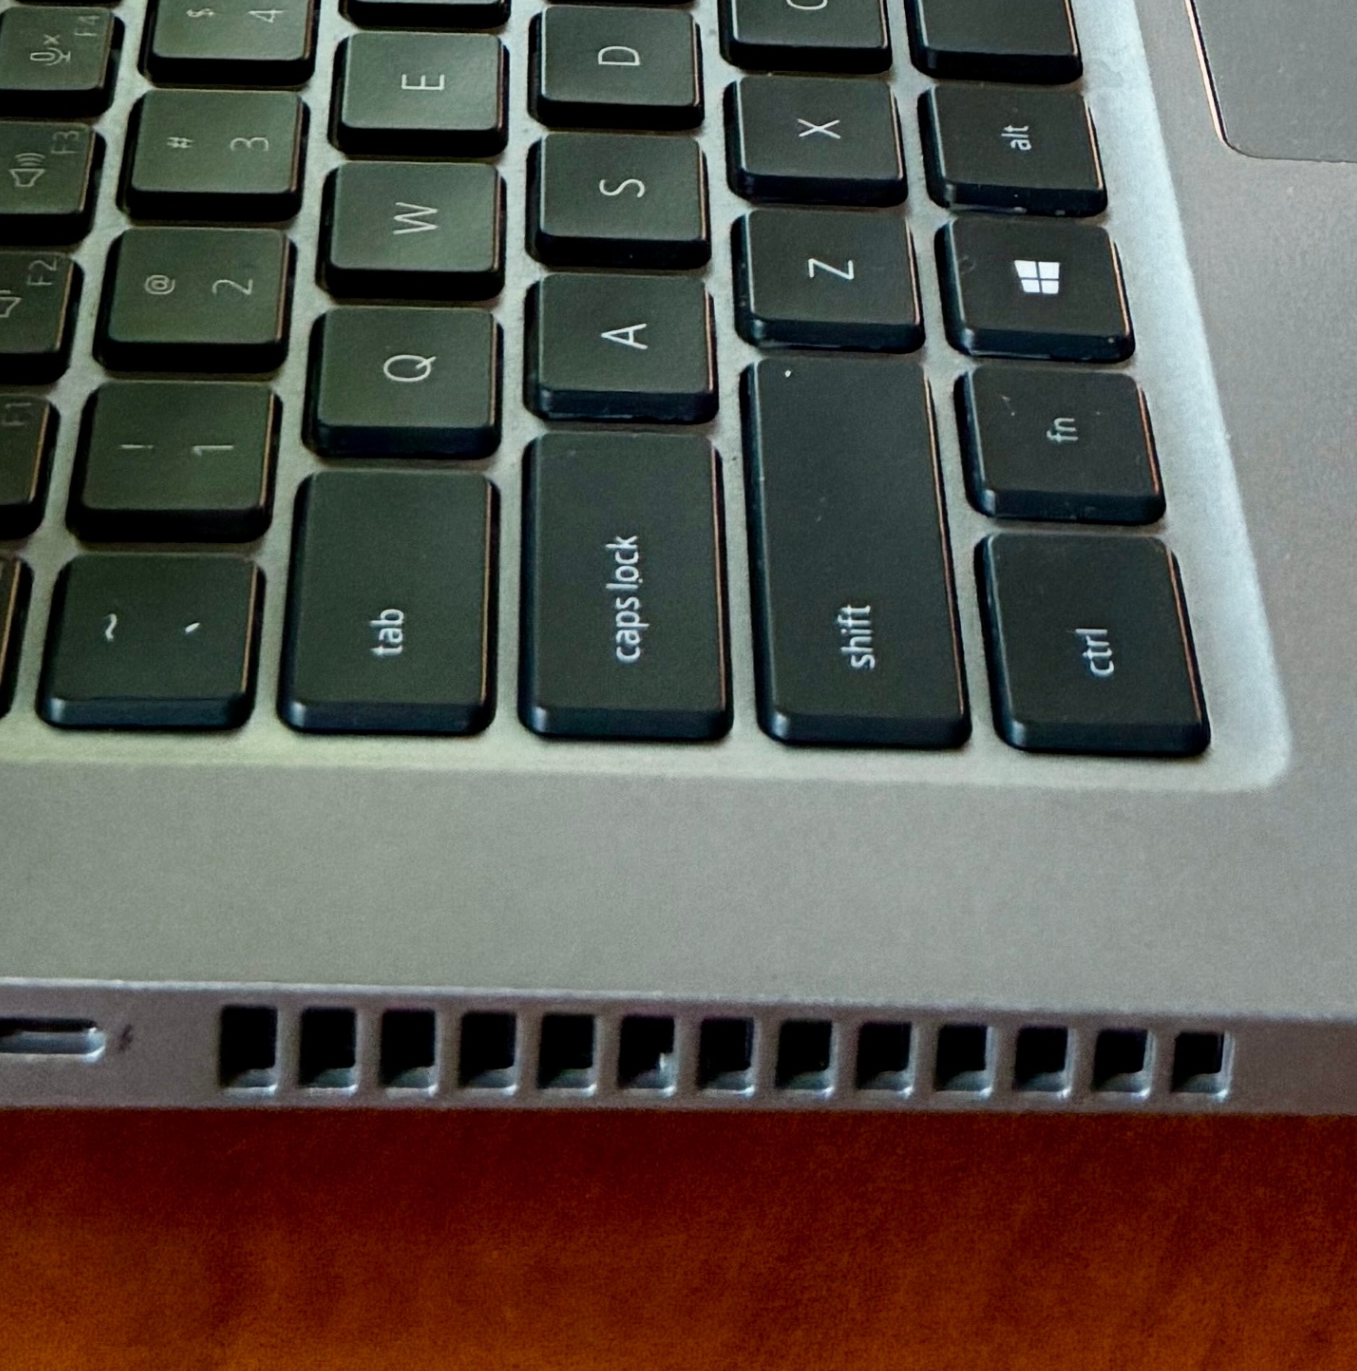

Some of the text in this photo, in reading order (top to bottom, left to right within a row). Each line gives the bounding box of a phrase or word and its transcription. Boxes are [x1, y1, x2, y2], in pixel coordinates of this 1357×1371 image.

[74, 16, 99, 36] F4
[249, 10, 283, 23] 4
[598, 46, 640, 66] D
[402, 75, 444, 90] E
[798, 119, 840, 138] X
[1002, 126, 1031, 150] alt
[51, 131, 79, 154] F3
[230, 137, 269, 151] 3
[599, 179, 645, 197] S
[394, 203, 438, 234] W
[27, 260, 57, 286] F2
[808, 259, 854, 280] Z
[213, 280, 253, 295] 2
[601, 324, 647, 349] A
[384, 355, 436, 382] Q
[1, 402, 31, 426] F1
[1047, 418, 1078, 442] fn
[193, 445, 233, 455] 1
[606, 536, 649, 661] caps lock
[371, 609, 404, 655] tab
[837, 605, 875, 668] shift
[1076, 629, 1114, 675] ctrl
